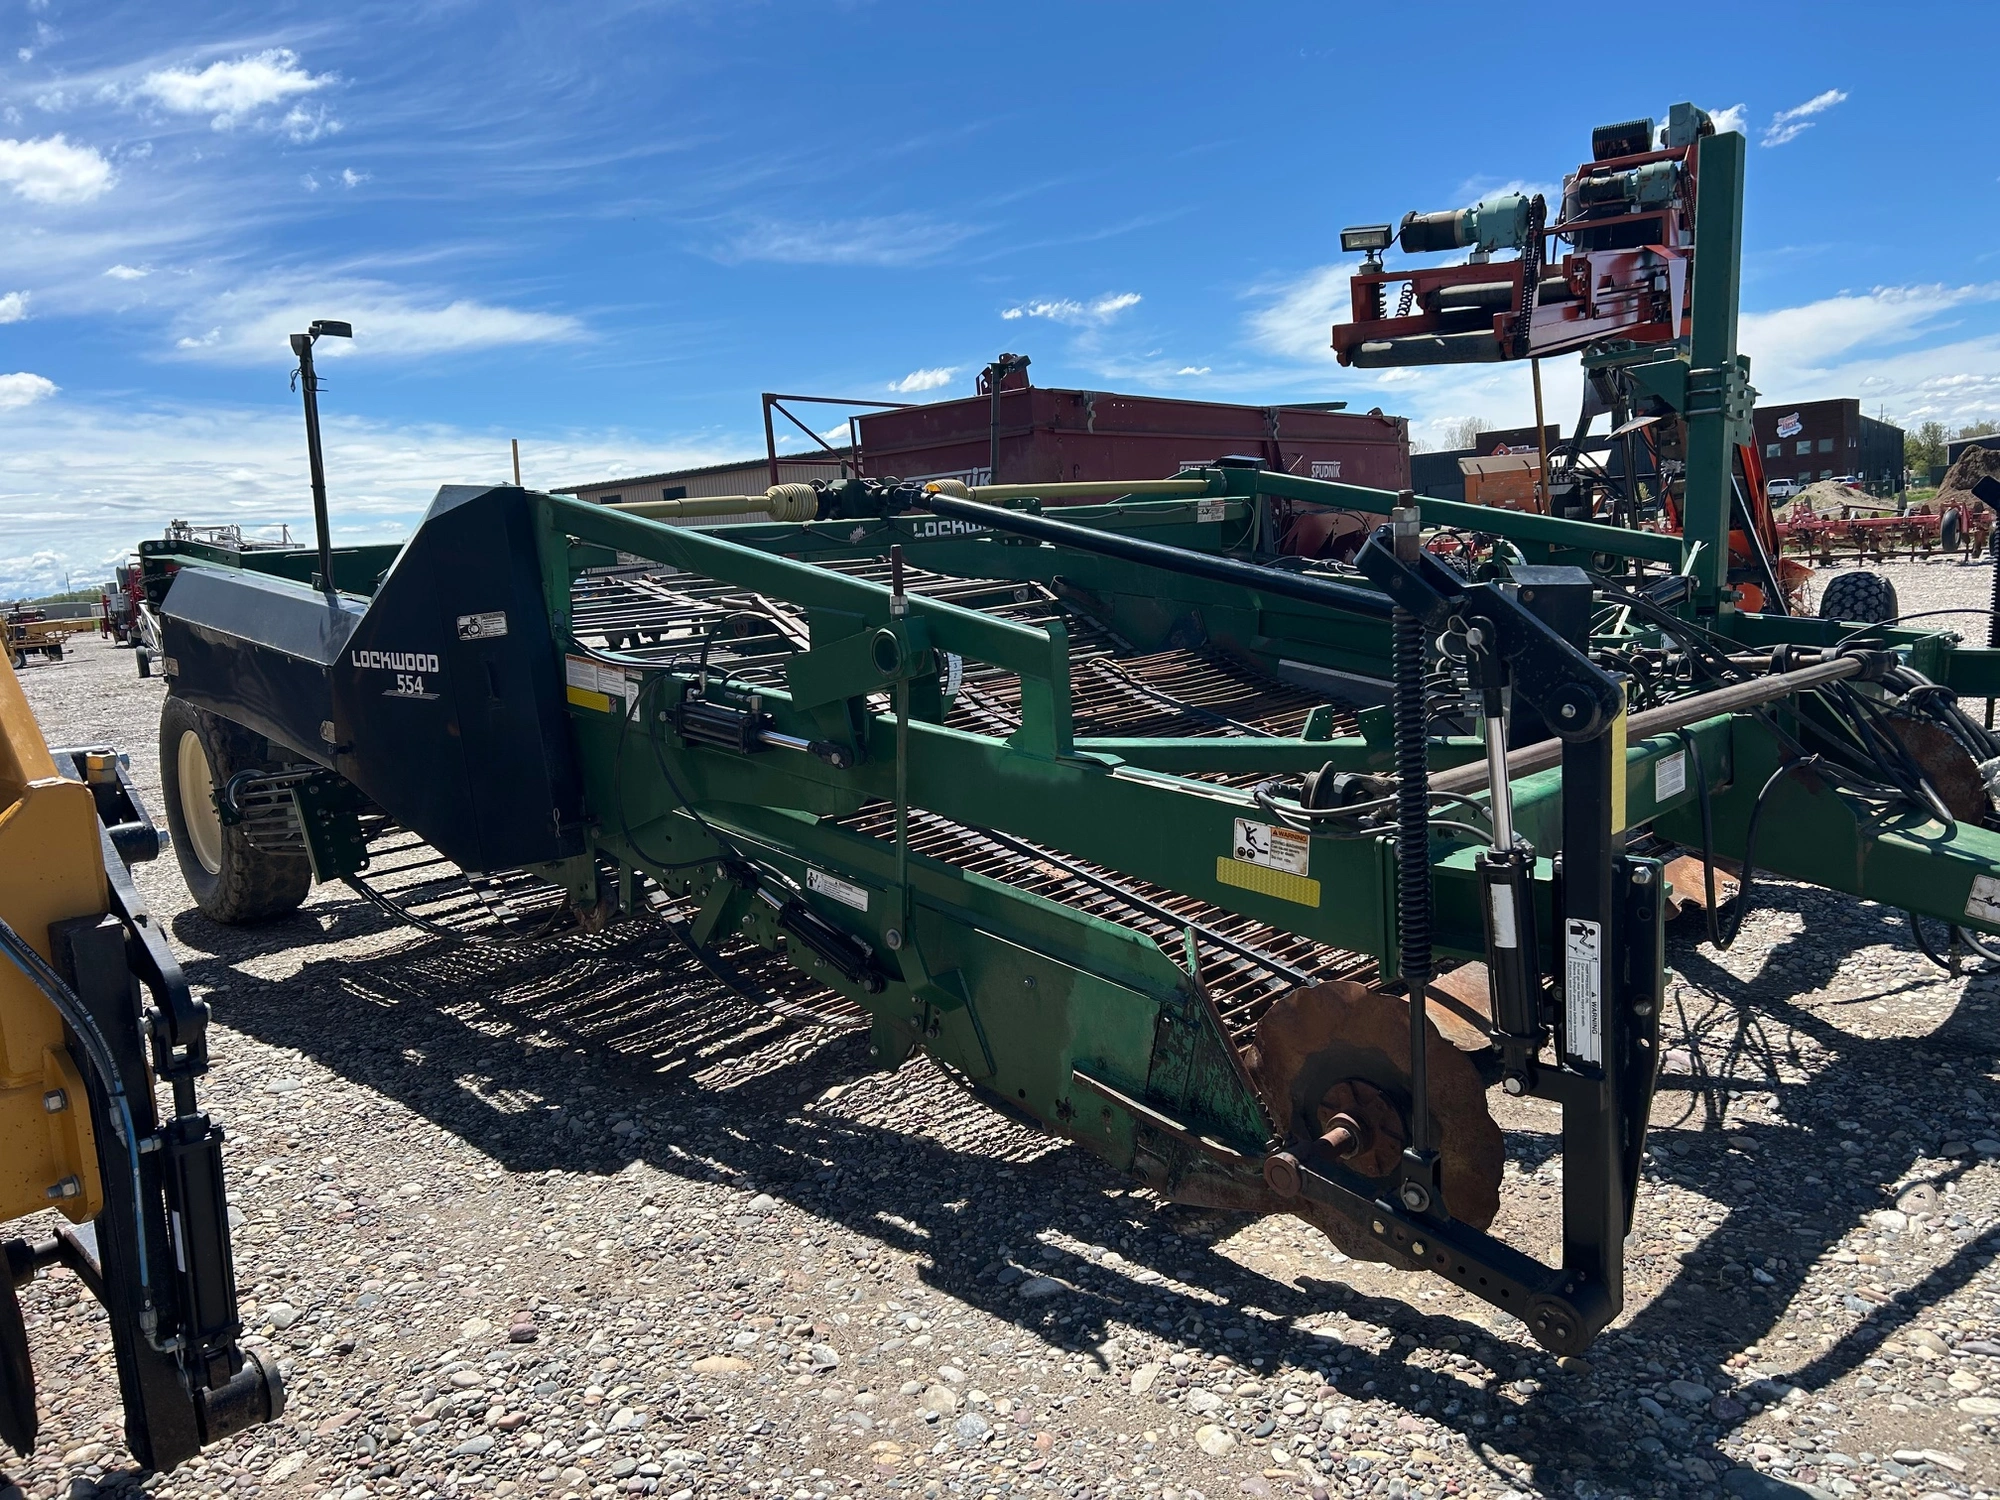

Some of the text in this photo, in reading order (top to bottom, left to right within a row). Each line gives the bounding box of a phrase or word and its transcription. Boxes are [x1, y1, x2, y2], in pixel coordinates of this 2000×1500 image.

[1311, 460, 1341, 478] SPUDNIK
[913, 520, 998, 538] LOCKW
[352, 650, 439, 673] LOCKWOOD
[397, 674, 424, 695] 554
[1279, 830, 1307, 842] WARNING
